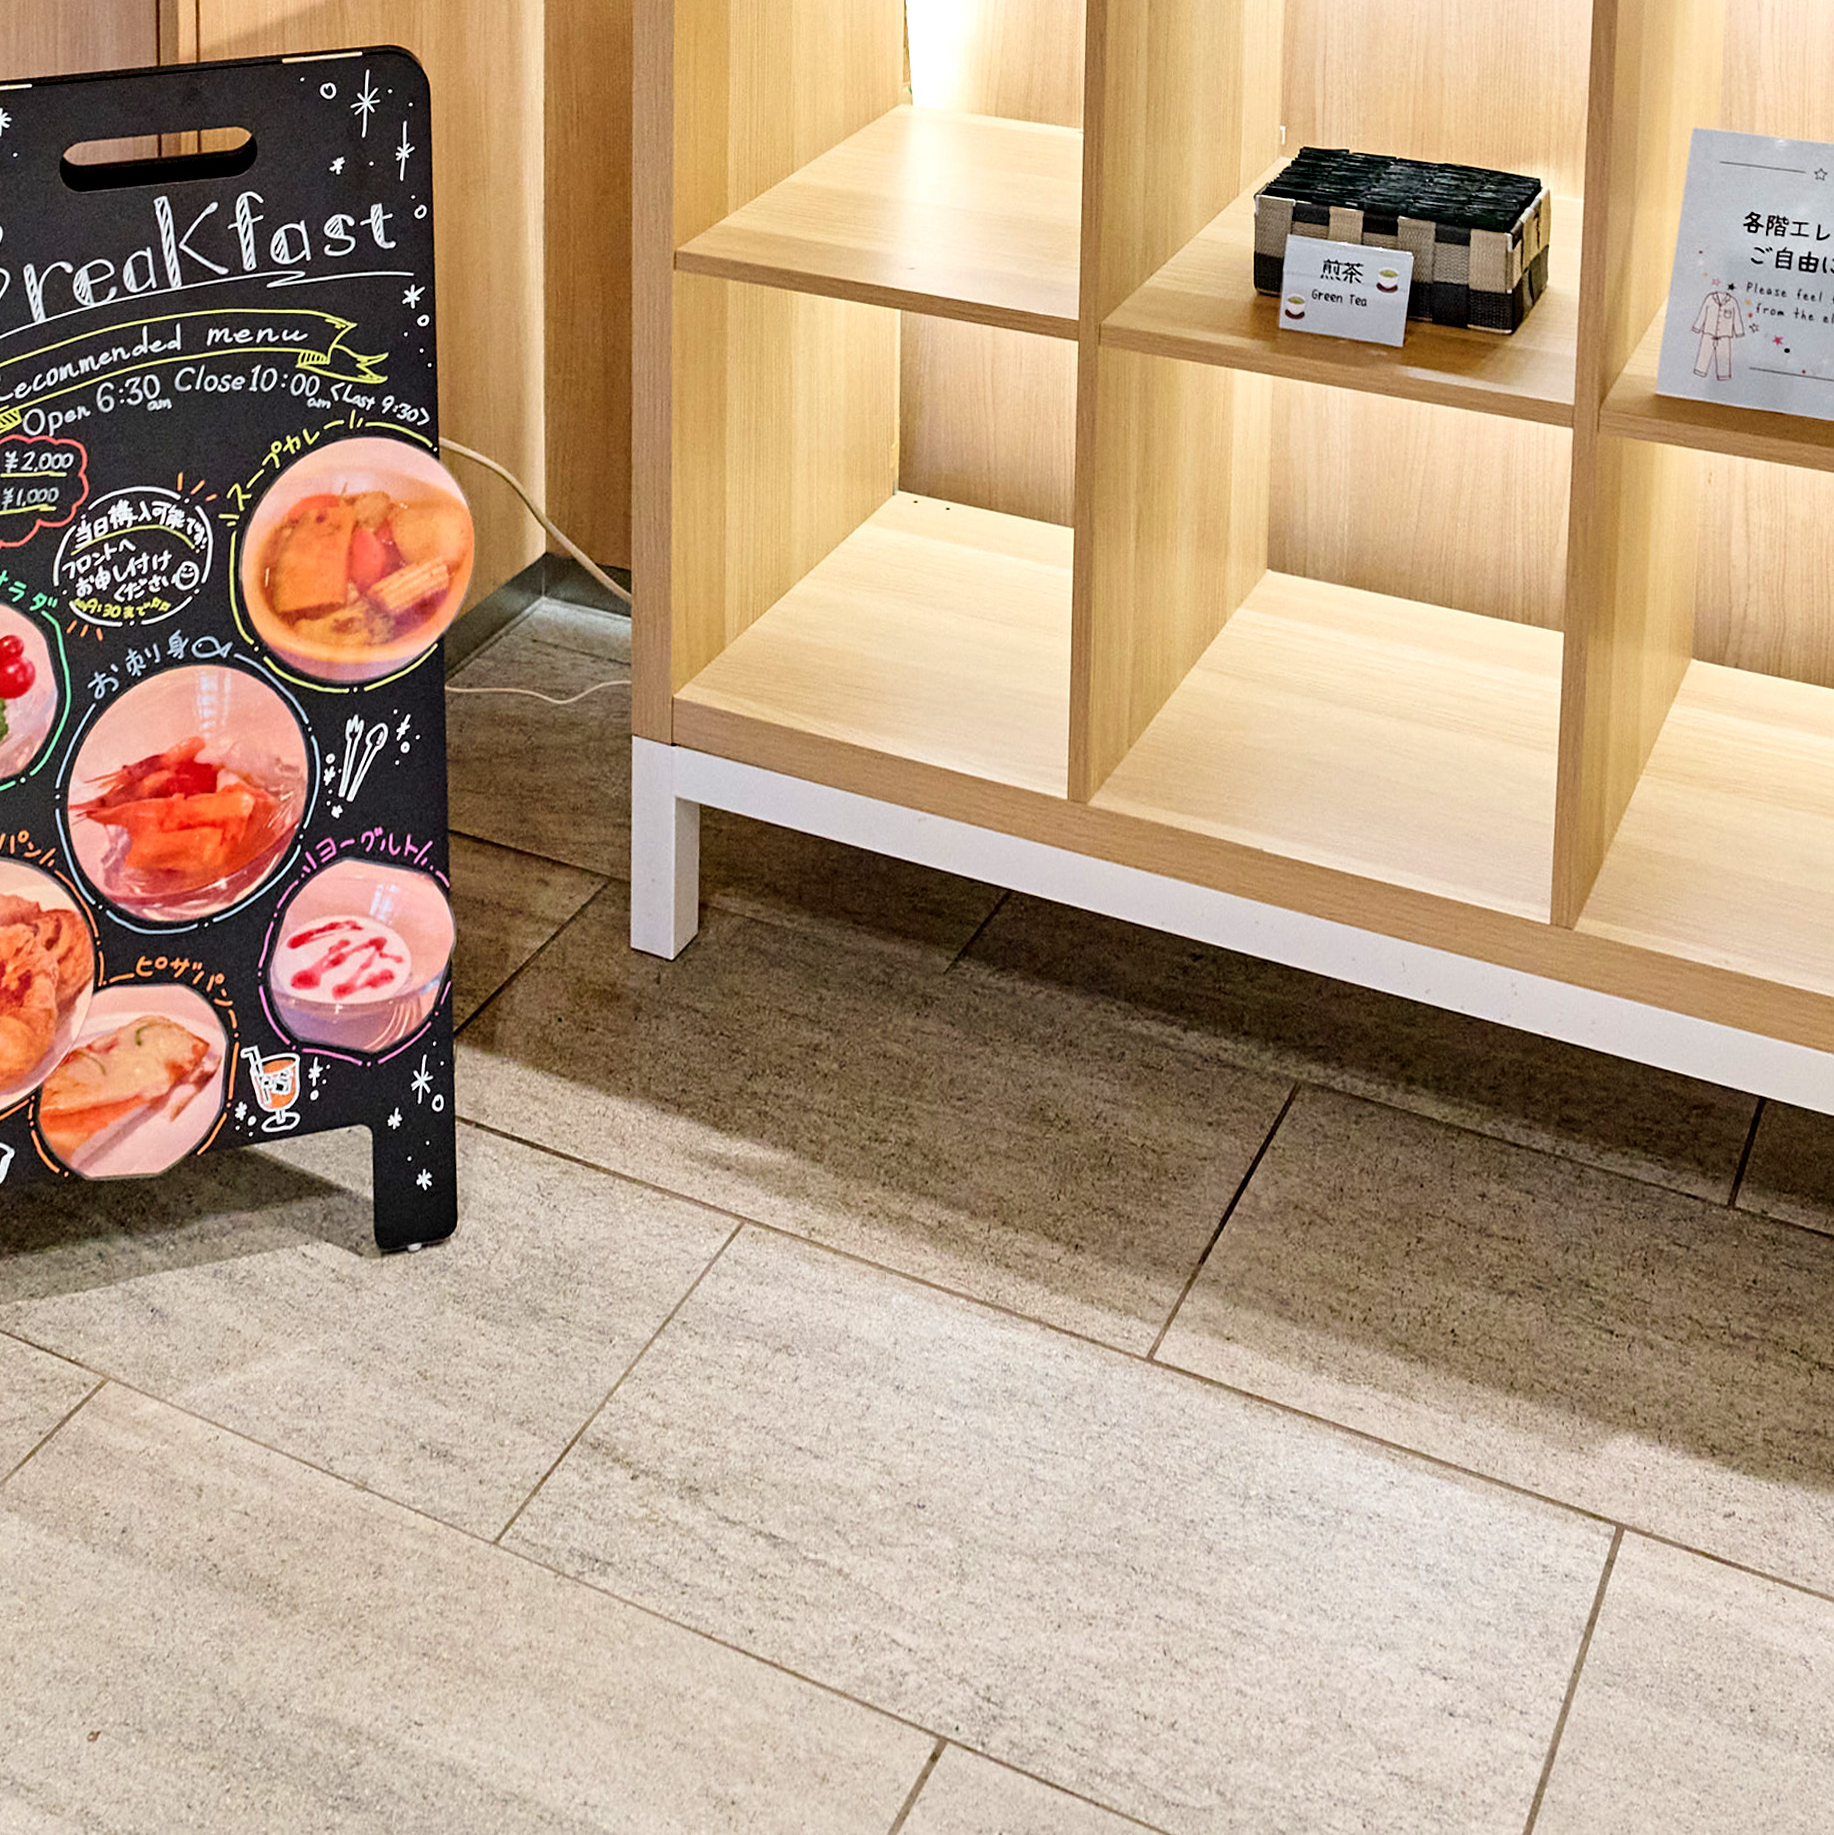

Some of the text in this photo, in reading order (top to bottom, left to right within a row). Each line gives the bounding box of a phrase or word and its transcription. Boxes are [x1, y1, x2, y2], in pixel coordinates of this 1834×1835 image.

[1320, 259, 1364, 284] 煎茶
[1311, 289, 1368, 307] Green Tea
[1746, 281, 1788, 299] Please
[1796, 288, 1823, 303] feel
[1755, 302, 1786, 317] from
[1794, 307, 1815, 322] the
[205, 328, 309, 347] menu
[23, 404, 92, 437] Open
[96, 374, 162, 414] 6:30
[147, 396, 173, 411] am
[173, 366, 247, 392] Close
[250, 365, 321, 396] 10:00
[306, 397, 333, 410] am
[315, 826, 419, 864] ヨーグルト
